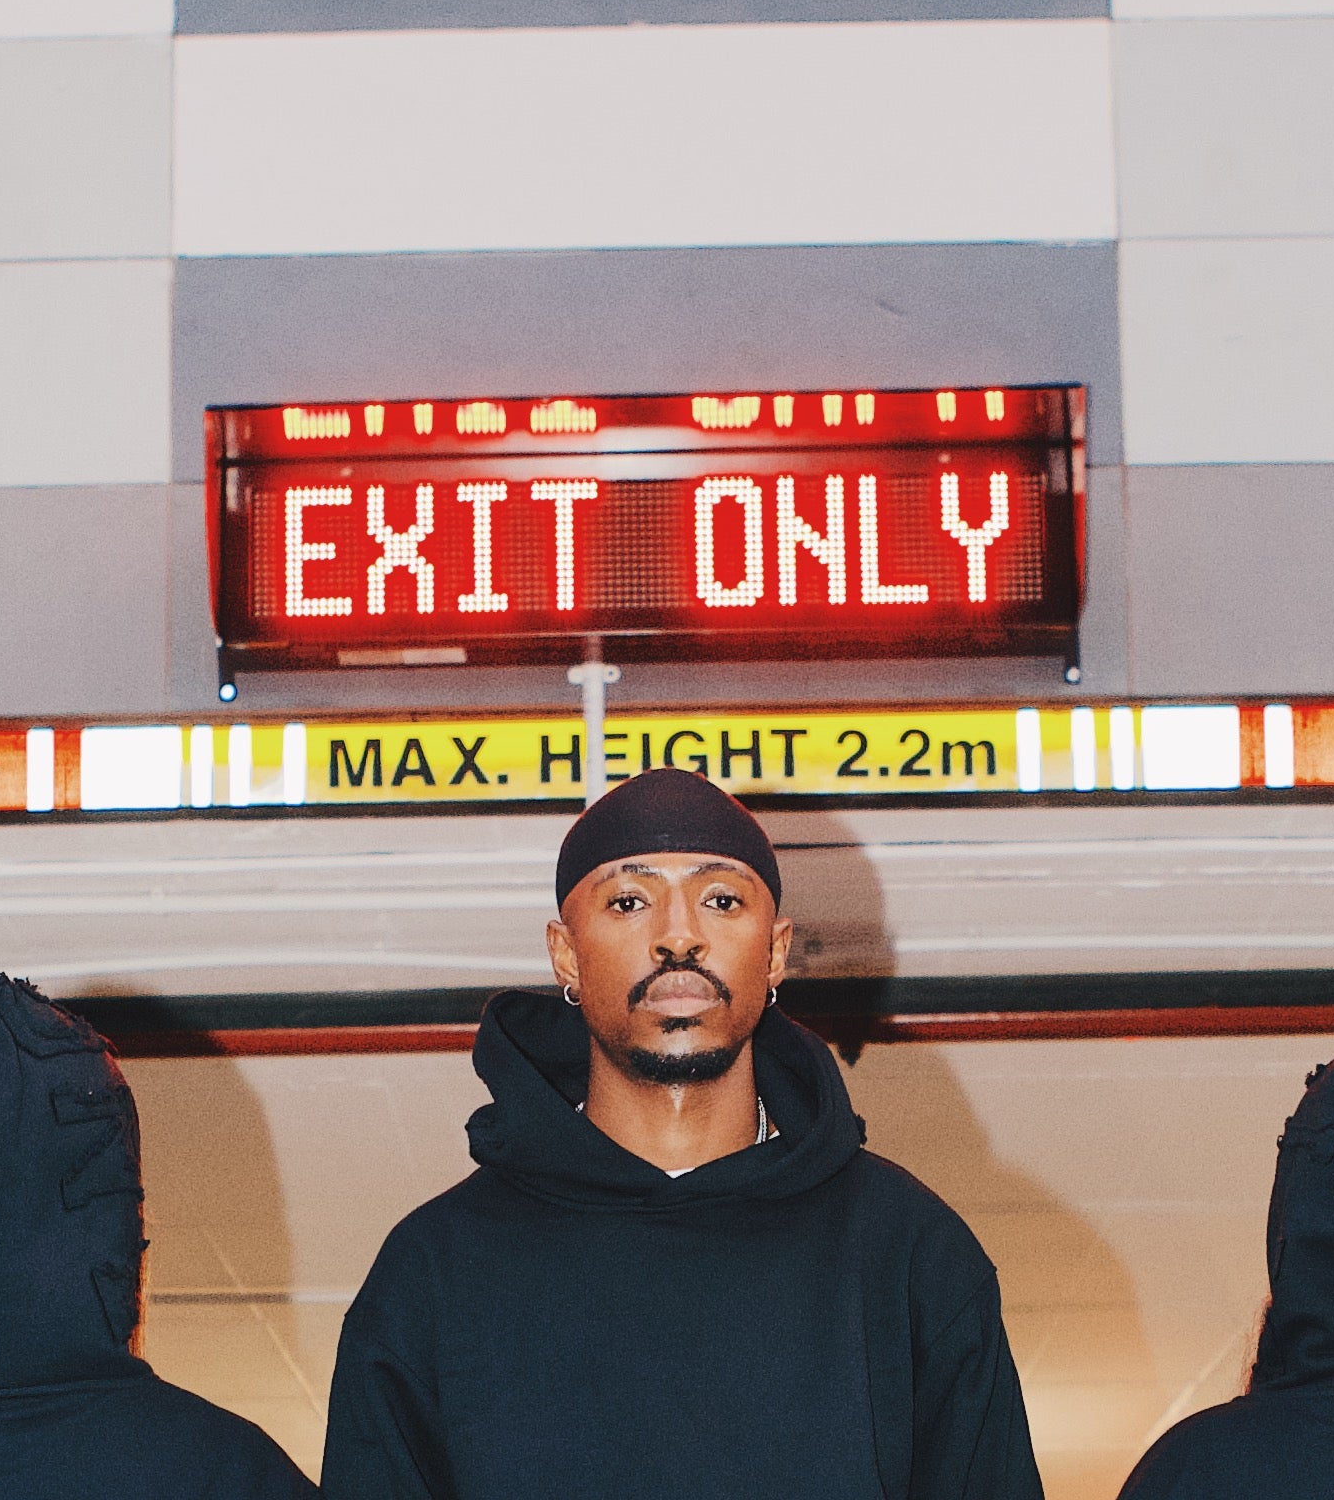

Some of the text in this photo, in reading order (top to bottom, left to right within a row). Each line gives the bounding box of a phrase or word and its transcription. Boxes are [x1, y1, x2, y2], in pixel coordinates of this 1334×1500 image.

[284, 470, 1010, 617] EXIT ONLY
[329, 729, 997, 788] MAX. HEIGHT 2.2m
